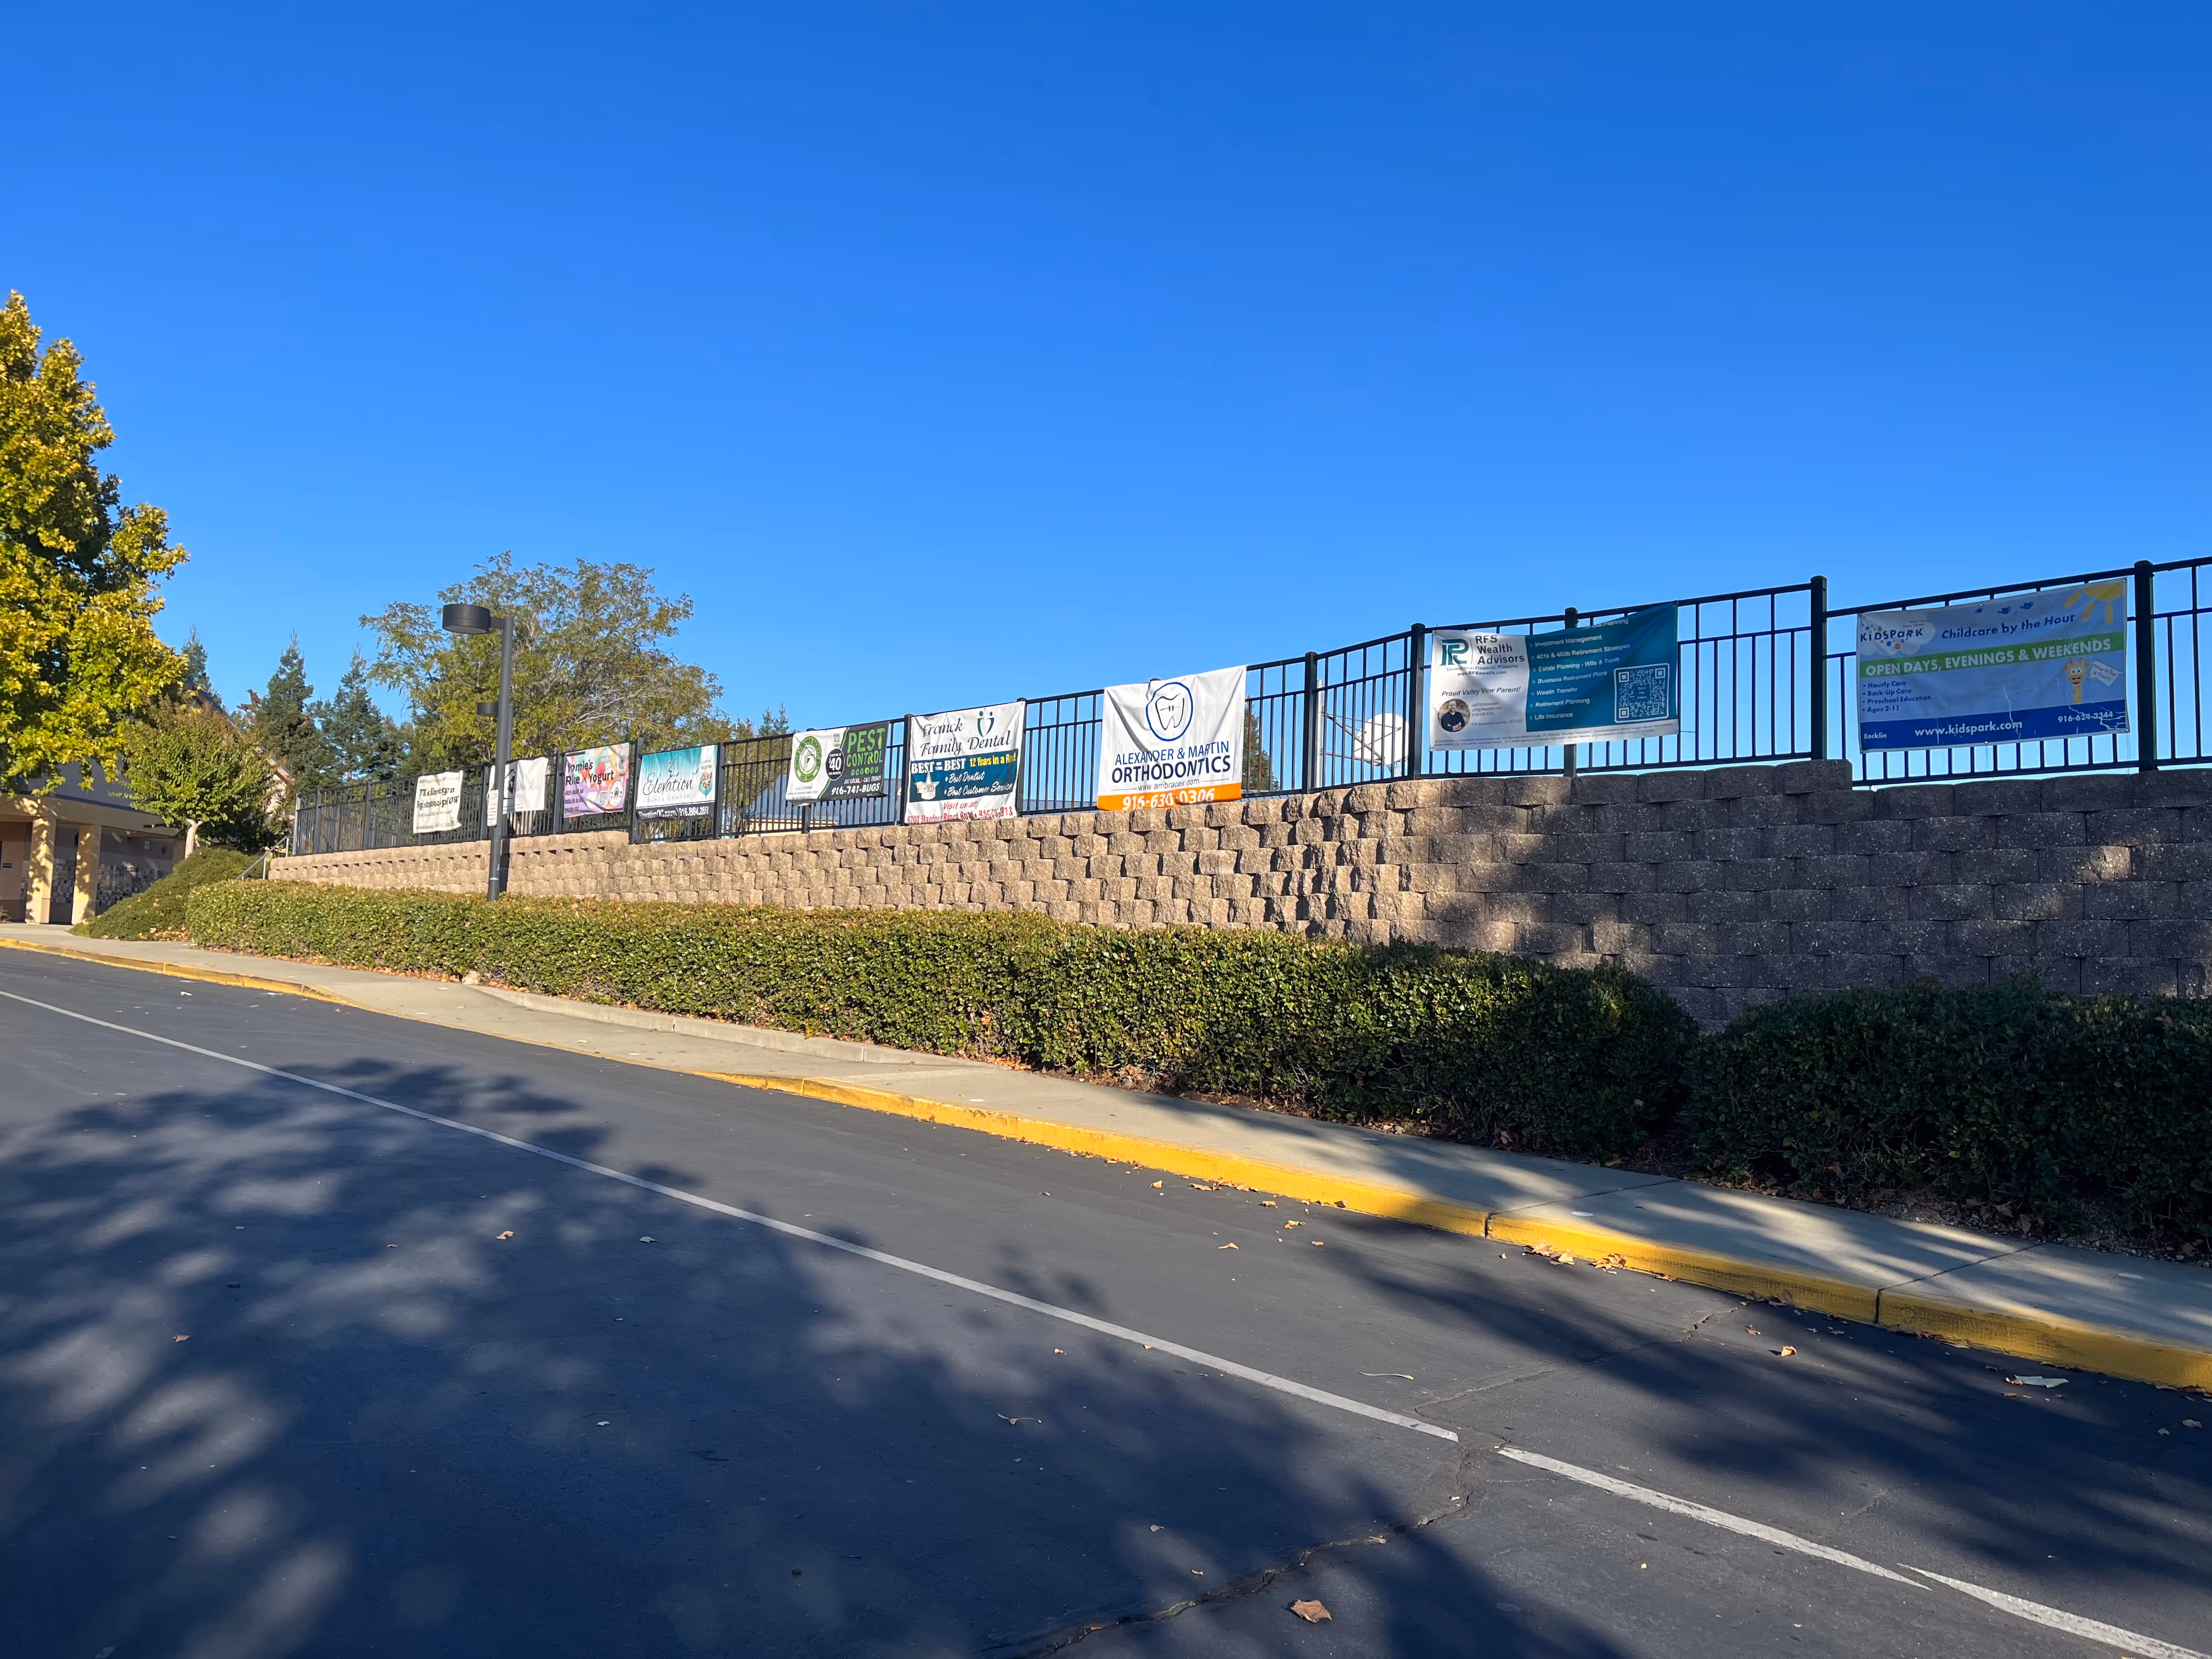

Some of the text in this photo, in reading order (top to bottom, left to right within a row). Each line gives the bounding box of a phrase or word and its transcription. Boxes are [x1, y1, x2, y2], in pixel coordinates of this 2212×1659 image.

[1942, 614, 2075, 639] Childcare by the Hour
[1475, 635, 1497, 644] RFS
[1535, 635, 1602, 647] Investment Management
[1477, 644, 1513, 654] Wealth
[1572, 648, 1602, 656] Retirement
[1477, 655, 1525, 665] Advisors
[1865, 638, 2112, 676] OPEN DAYS, EVENINGS & WEEKENDS
[1563, 674, 1592, 682] Retirement
[1867, 696, 1899, 704] Preschool
[2057, 712, 2113, 723] 916-624-2344
[922, 718, 963, 737] Franck
[1915, 721, 2023, 736] www.kidspark.com
[847, 727, 885, 754] PEST
[921, 730, 1011, 757] Family Dental
[846, 750, 883, 768] CONTROL
[1115, 740, 1229, 766] ALEXANDER & MARTIN
[567, 759, 594, 773] Yomie's
[828, 757, 842, 771] $40
[911, 762, 935, 774] BEST
[944, 758, 967, 771] BEST
[969, 758, 977, 767] 12
[977, 756, 992, 766] Years
[992, 755, 999, 764] in
[1111, 755, 1231, 783] ORTHODONTICS
[588, 770, 614, 785] Yogurt
[642, 772, 693, 795] Elevation
[948, 771, 985, 783] Best Dentist
[831, 782, 881, 795] 916-741-BUGS
[947, 786, 961, 797] Best
[944, 802, 958, 810] Visit
[1122, 788, 1216, 810] 916-630-0306
